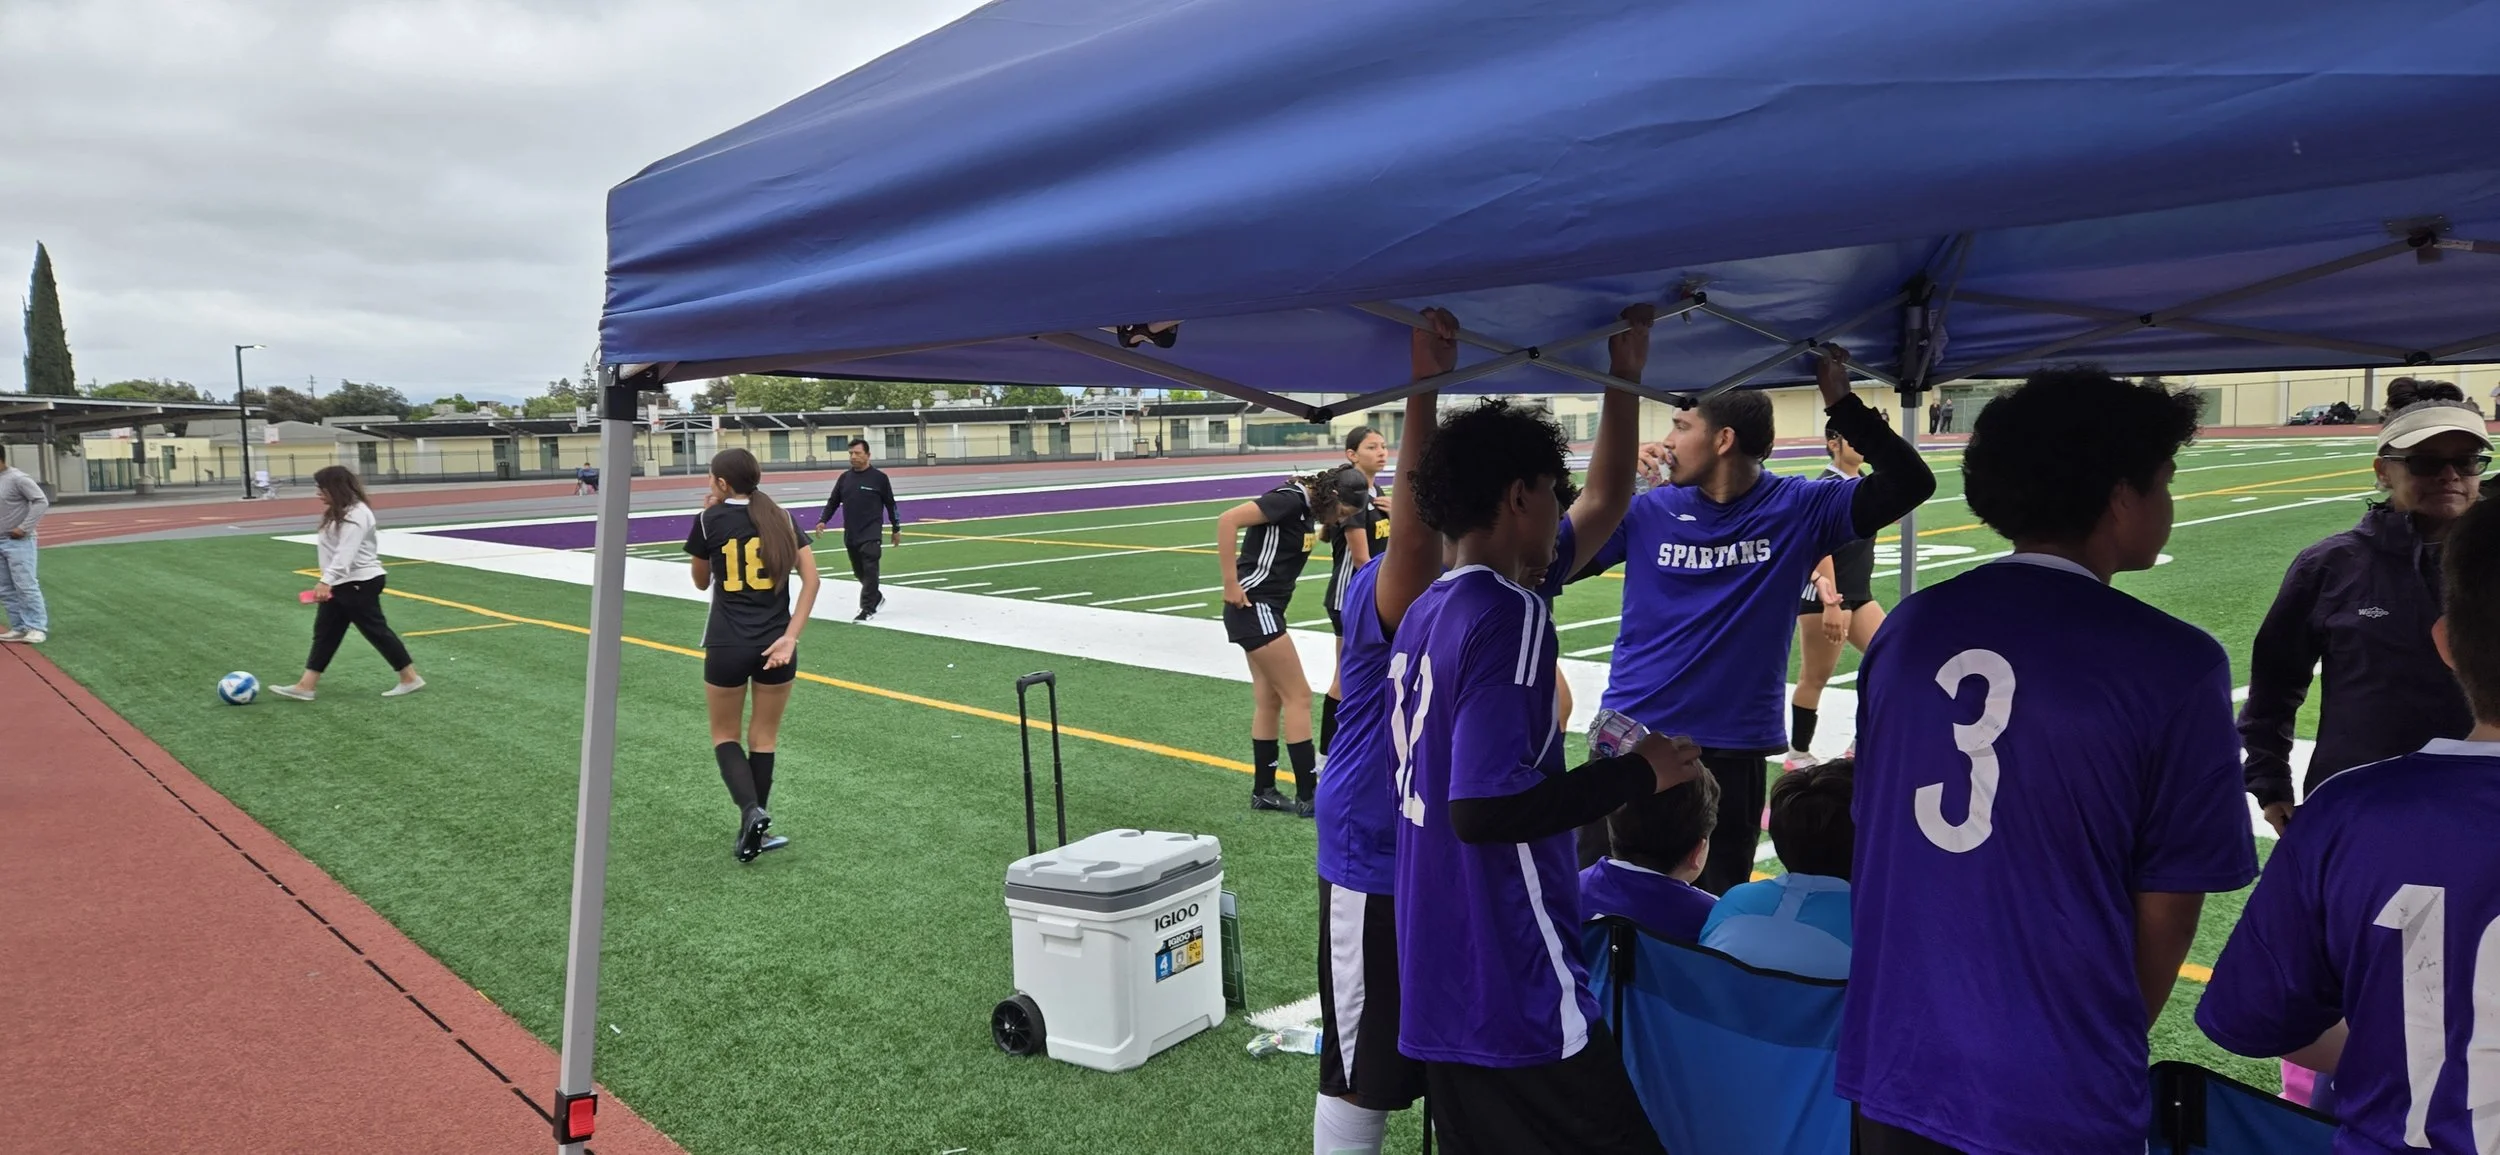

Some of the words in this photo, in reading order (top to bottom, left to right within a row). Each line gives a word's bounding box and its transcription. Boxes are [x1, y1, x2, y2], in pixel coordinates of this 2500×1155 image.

[722, 537, 774, 591] 18
[1657, 539, 1771, 569] SPARTANS
[1387, 652, 1433, 827] 12
[1914, 648, 2017, 853] 3
[1155, 904, 1199, 932] IGLOO
[1168, 932, 1191, 947] IGLOO
